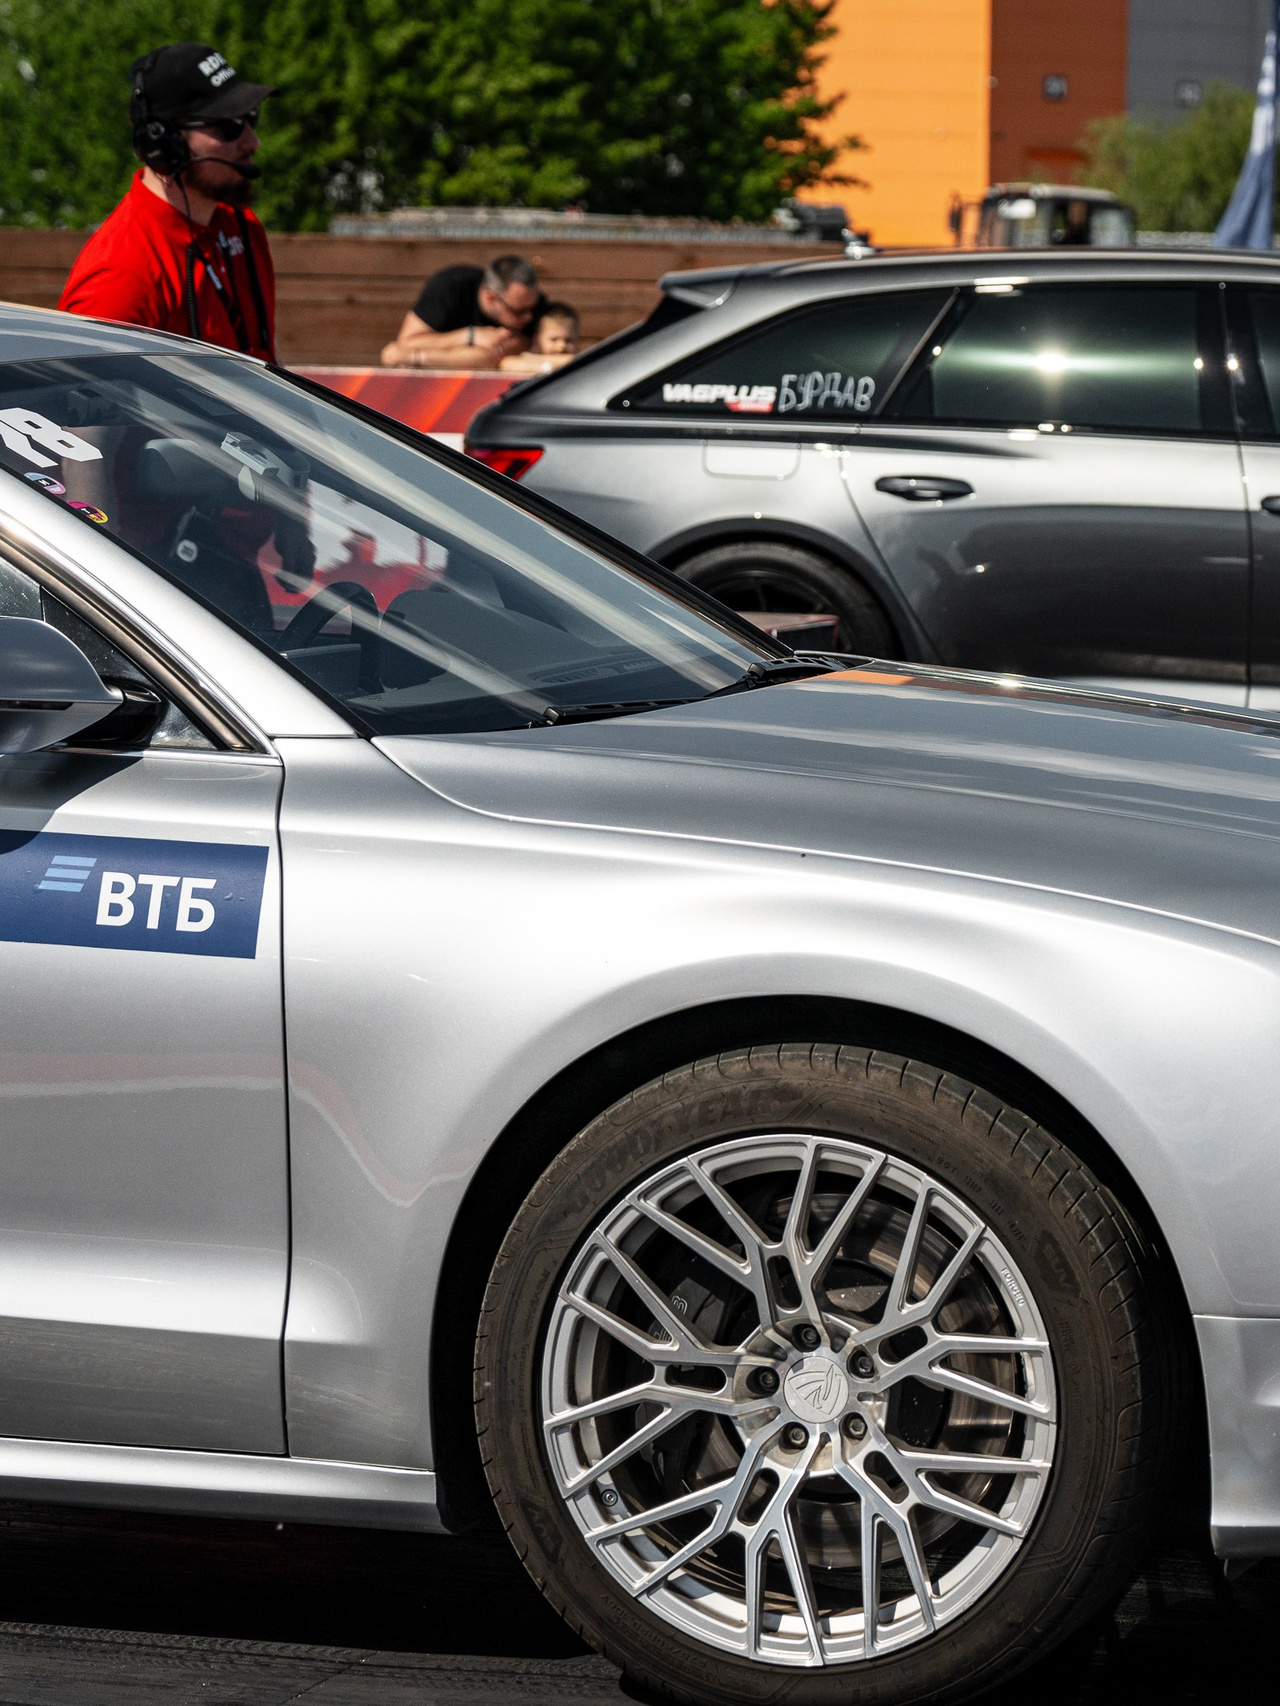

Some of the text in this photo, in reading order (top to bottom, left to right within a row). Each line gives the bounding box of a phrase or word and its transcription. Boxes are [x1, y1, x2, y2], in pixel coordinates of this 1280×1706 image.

[663, 383, 777, 403] VAGPLUS
[96, 871, 217, 932] ВТБ
[1001, 1267, 1025, 1307] FORGED
